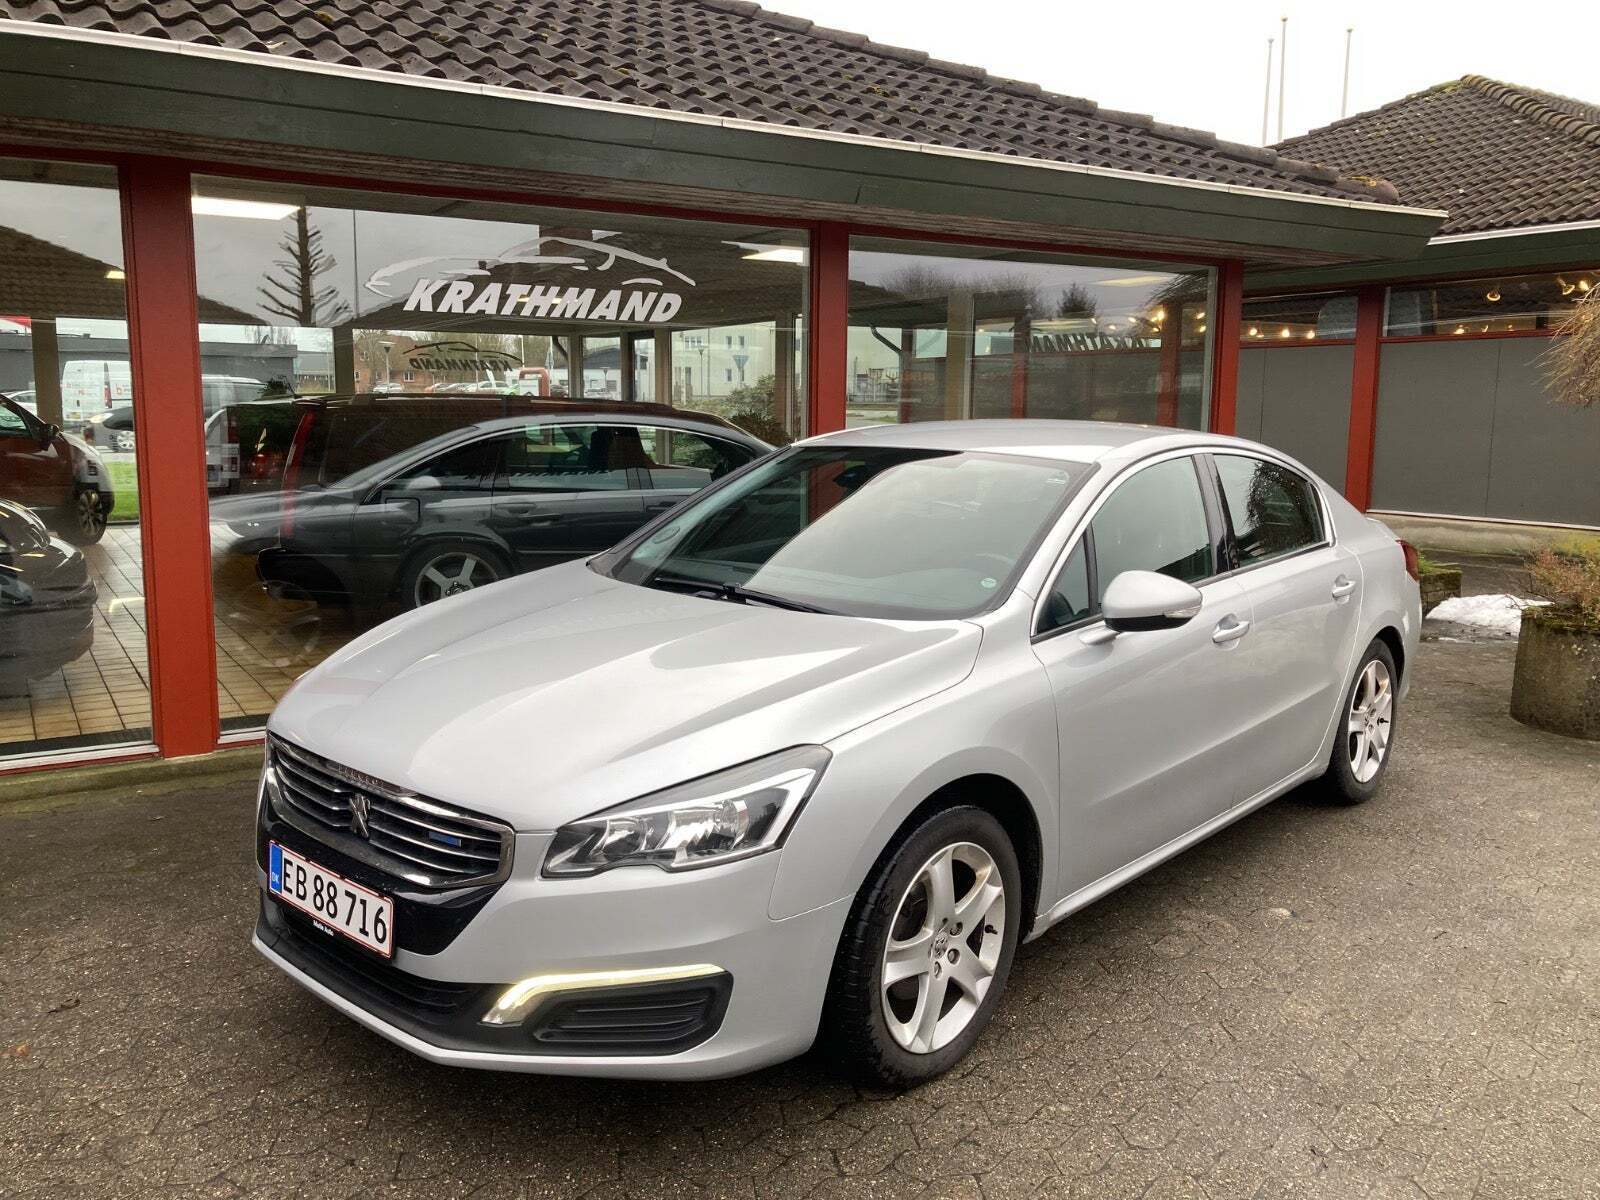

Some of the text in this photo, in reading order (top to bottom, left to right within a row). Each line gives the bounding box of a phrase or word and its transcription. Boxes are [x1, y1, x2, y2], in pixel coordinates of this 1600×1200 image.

[402, 279, 682, 323] KRATHMAND
[283, 858, 387, 944] EB 88 716
